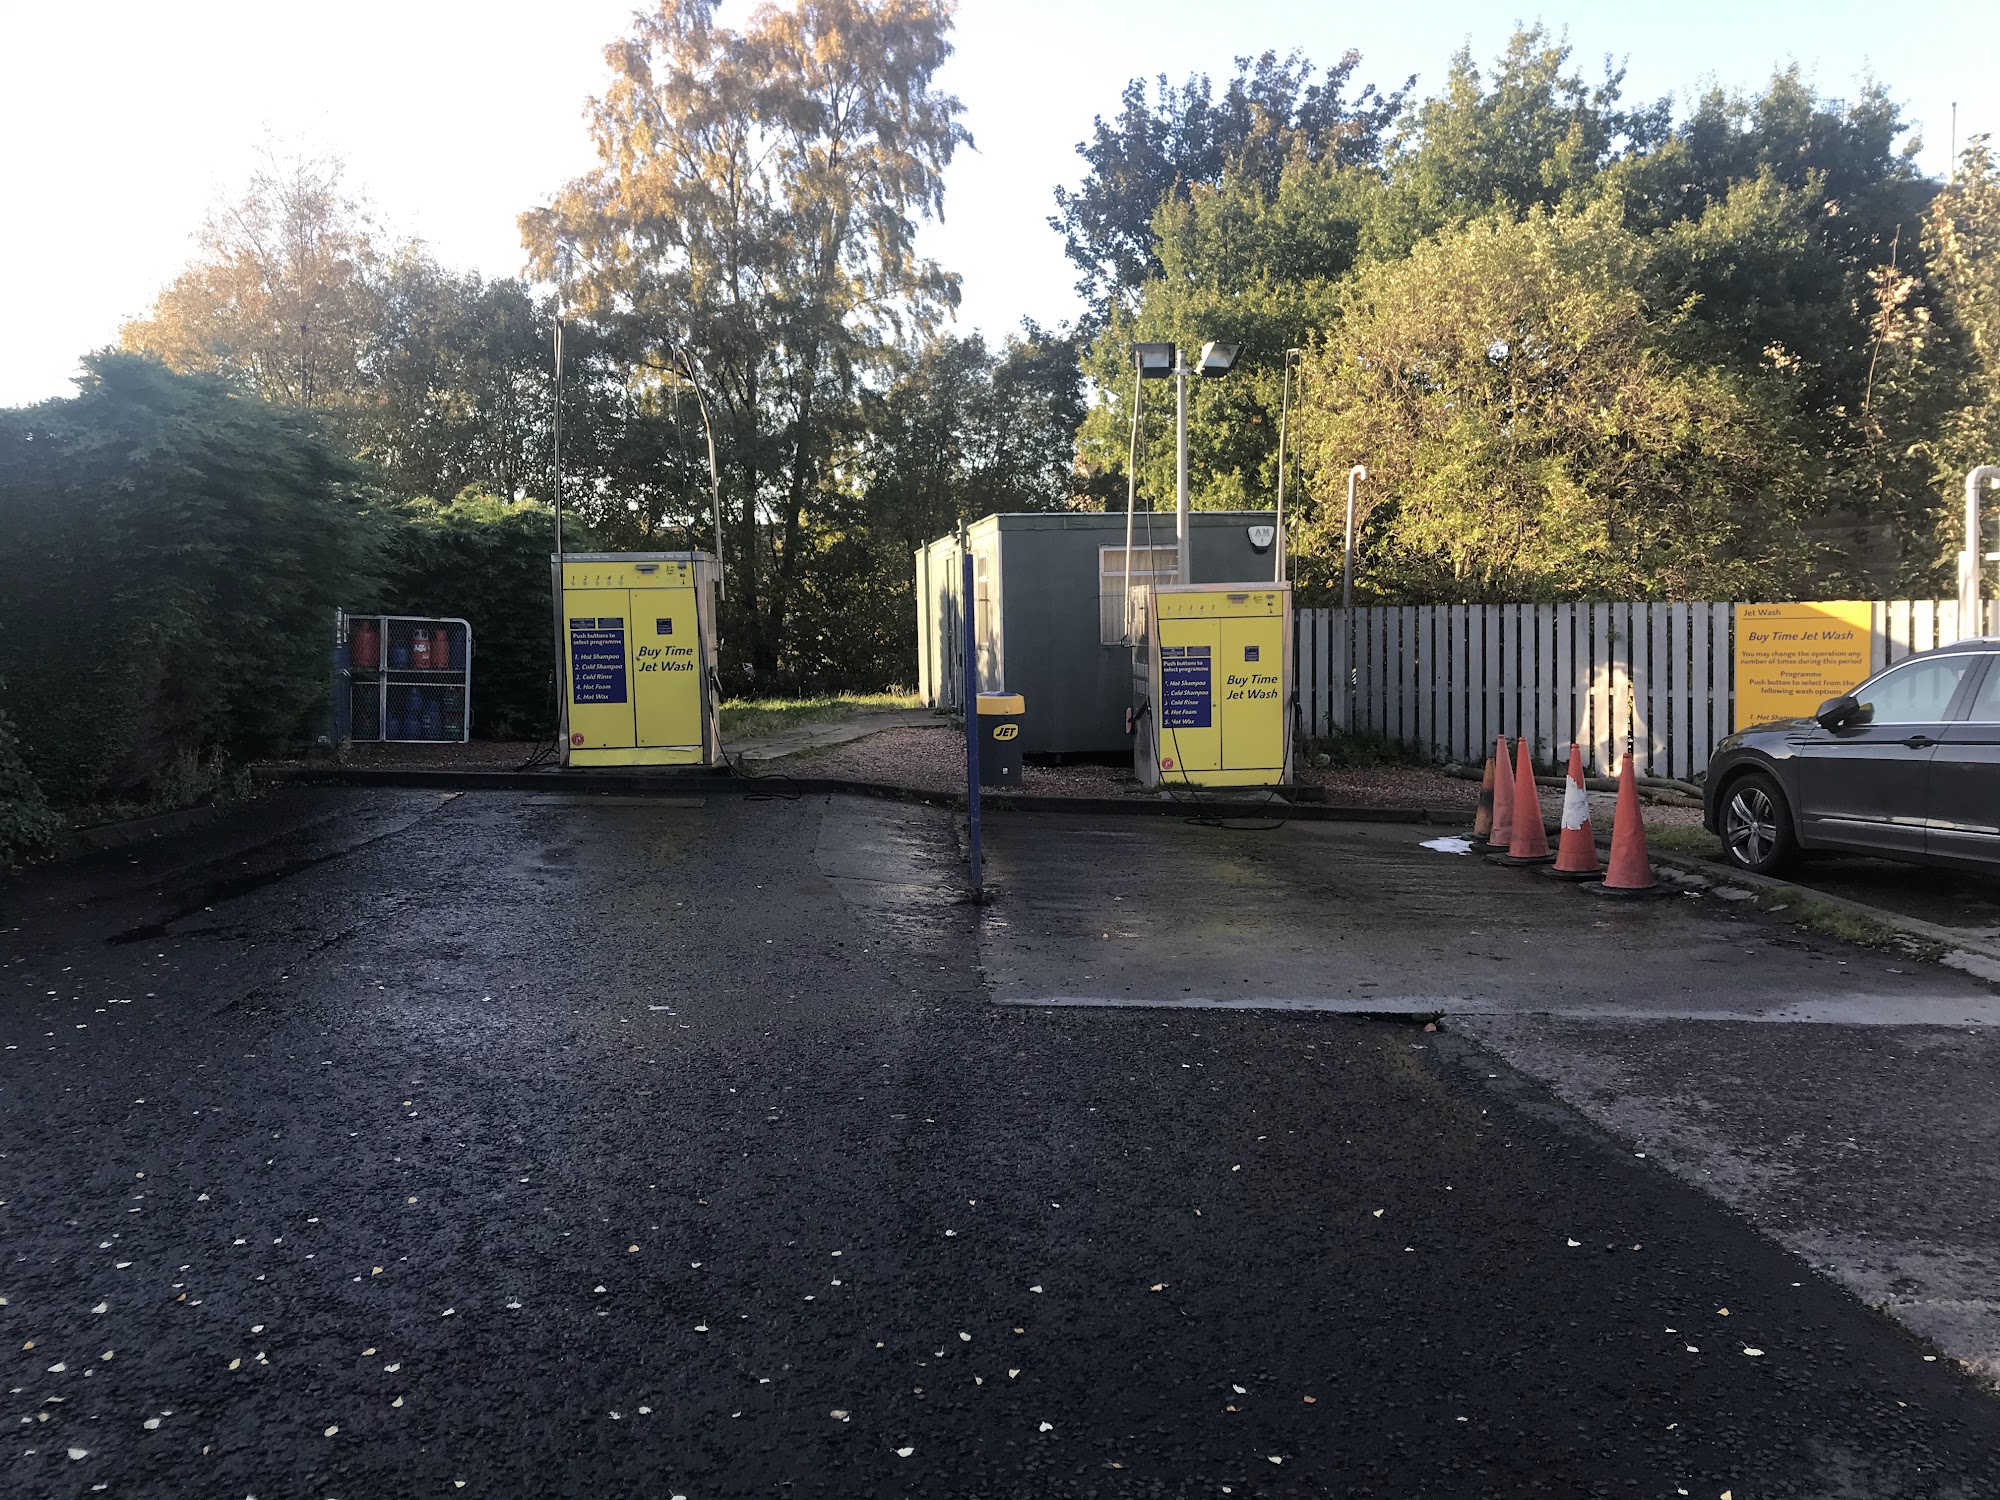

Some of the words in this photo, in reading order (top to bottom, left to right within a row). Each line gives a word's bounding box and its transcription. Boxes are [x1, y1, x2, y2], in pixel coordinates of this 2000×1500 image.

[1749, 632, 1769, 644] Buy
[1772, 632, 1798, 640] Time
[1801, 631, 1818, 640] Jet
[1822, 631, 1853, 640] Wash
[639, 646, 661, 660] Buy
[665, 645, 693, 656] Time
[638, 662, 658, 672] Jet
[662, 661, 694, 671] Wash
[1227, 675, 1248, 687] Buy
[1252, 674, 1278, 684] Time
[1226, 690, 1244, 699] Jet
[1248, 689, 1278, 699] Wash
[996, 728, 1017, 737] JET
